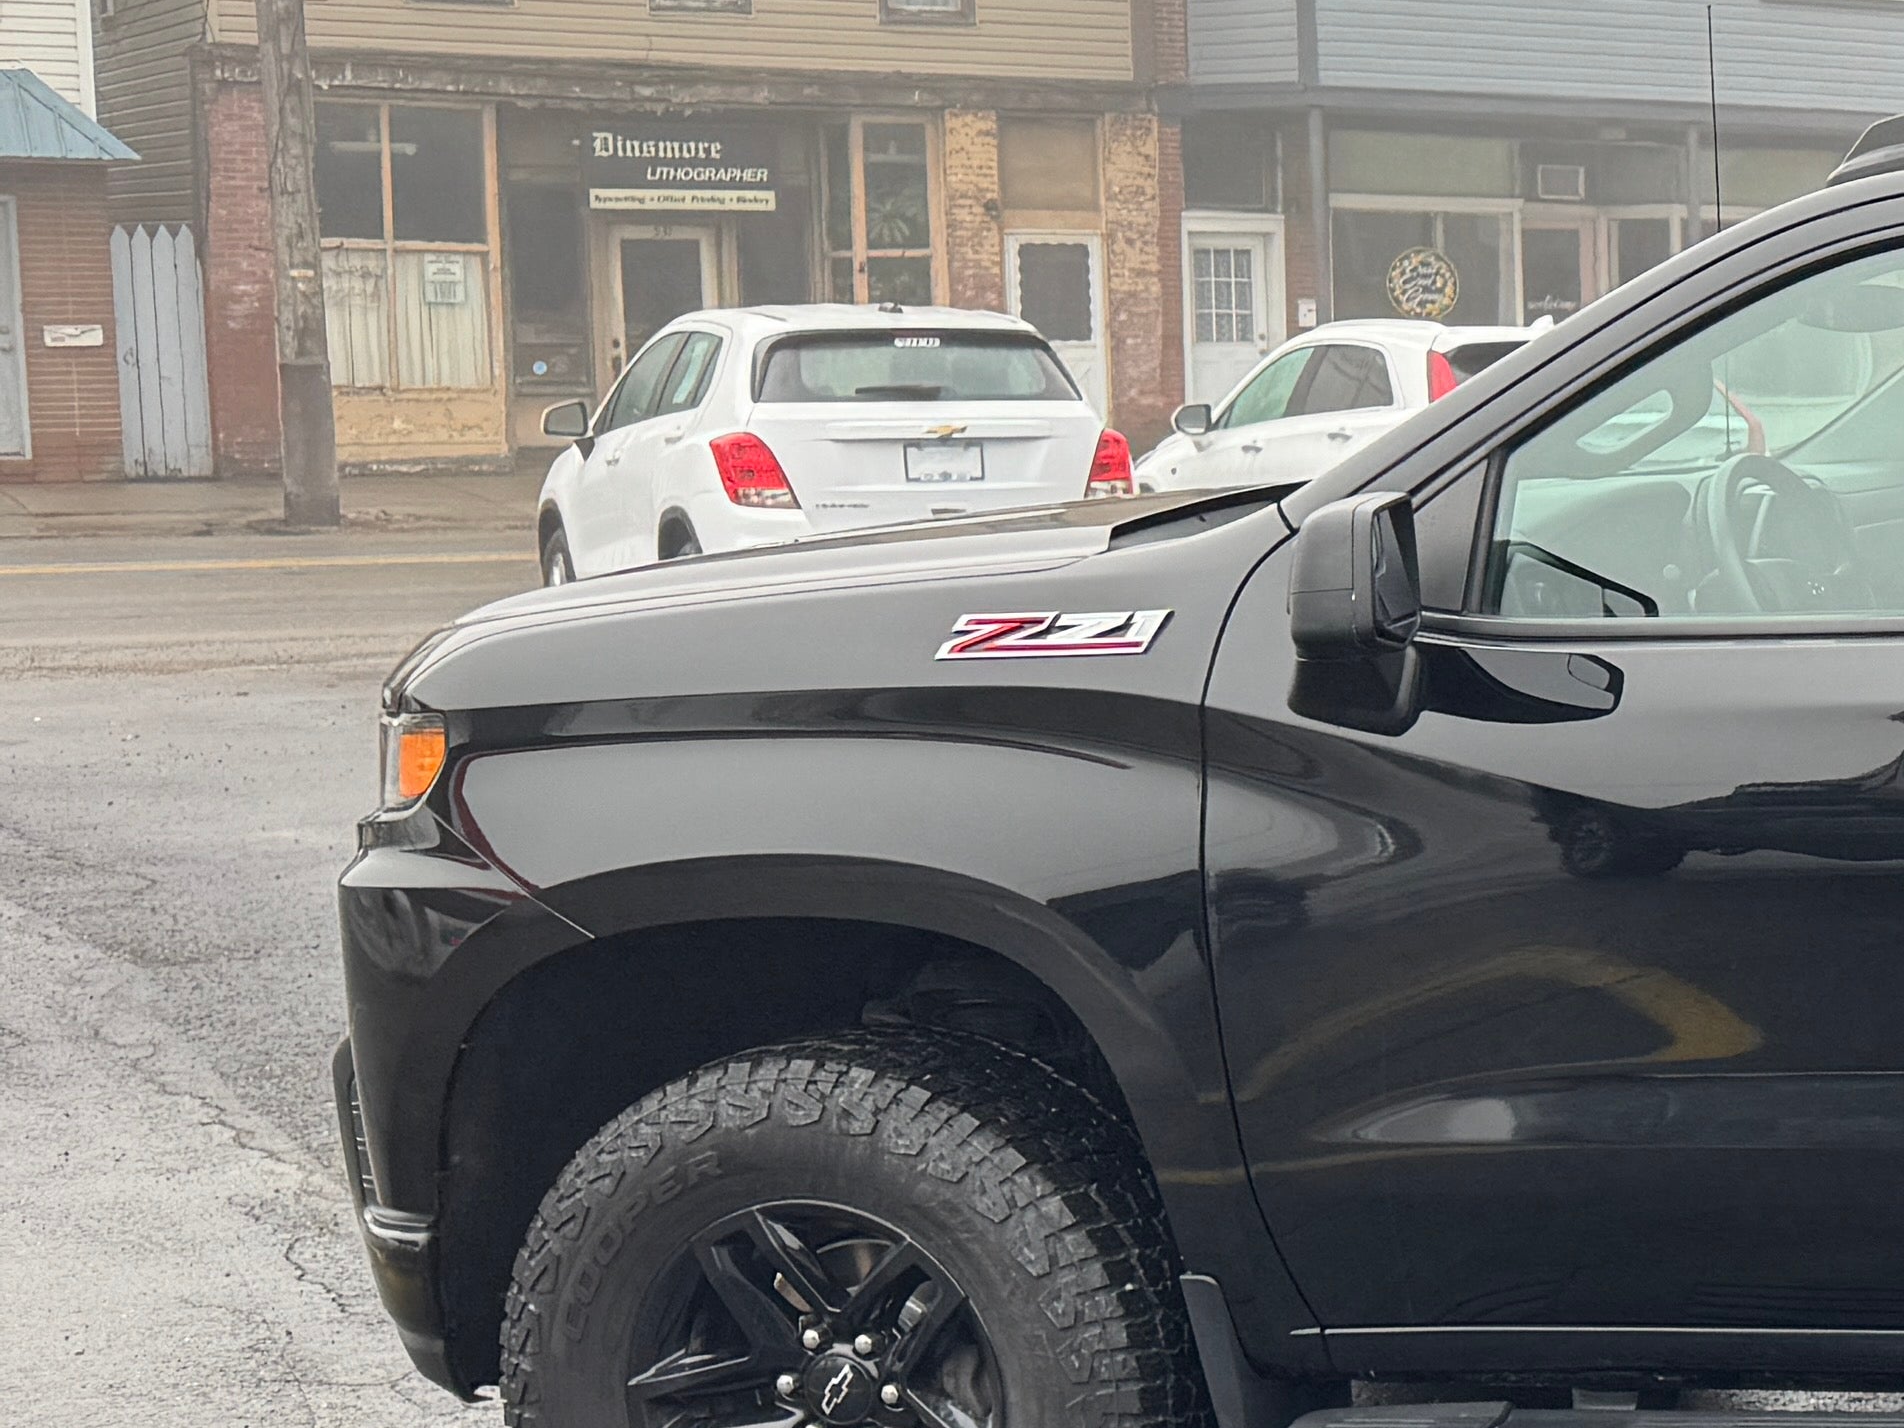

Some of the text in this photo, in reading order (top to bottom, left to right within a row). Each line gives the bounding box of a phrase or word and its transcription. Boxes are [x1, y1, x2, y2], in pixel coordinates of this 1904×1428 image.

[592, 132, 722, 159] Dinsmore
[646, 165, 769, 183] LITHOGRAPHER
[934, 608, 1175, 660] Z71
[562, 1150, 724, 1344] COOPER
